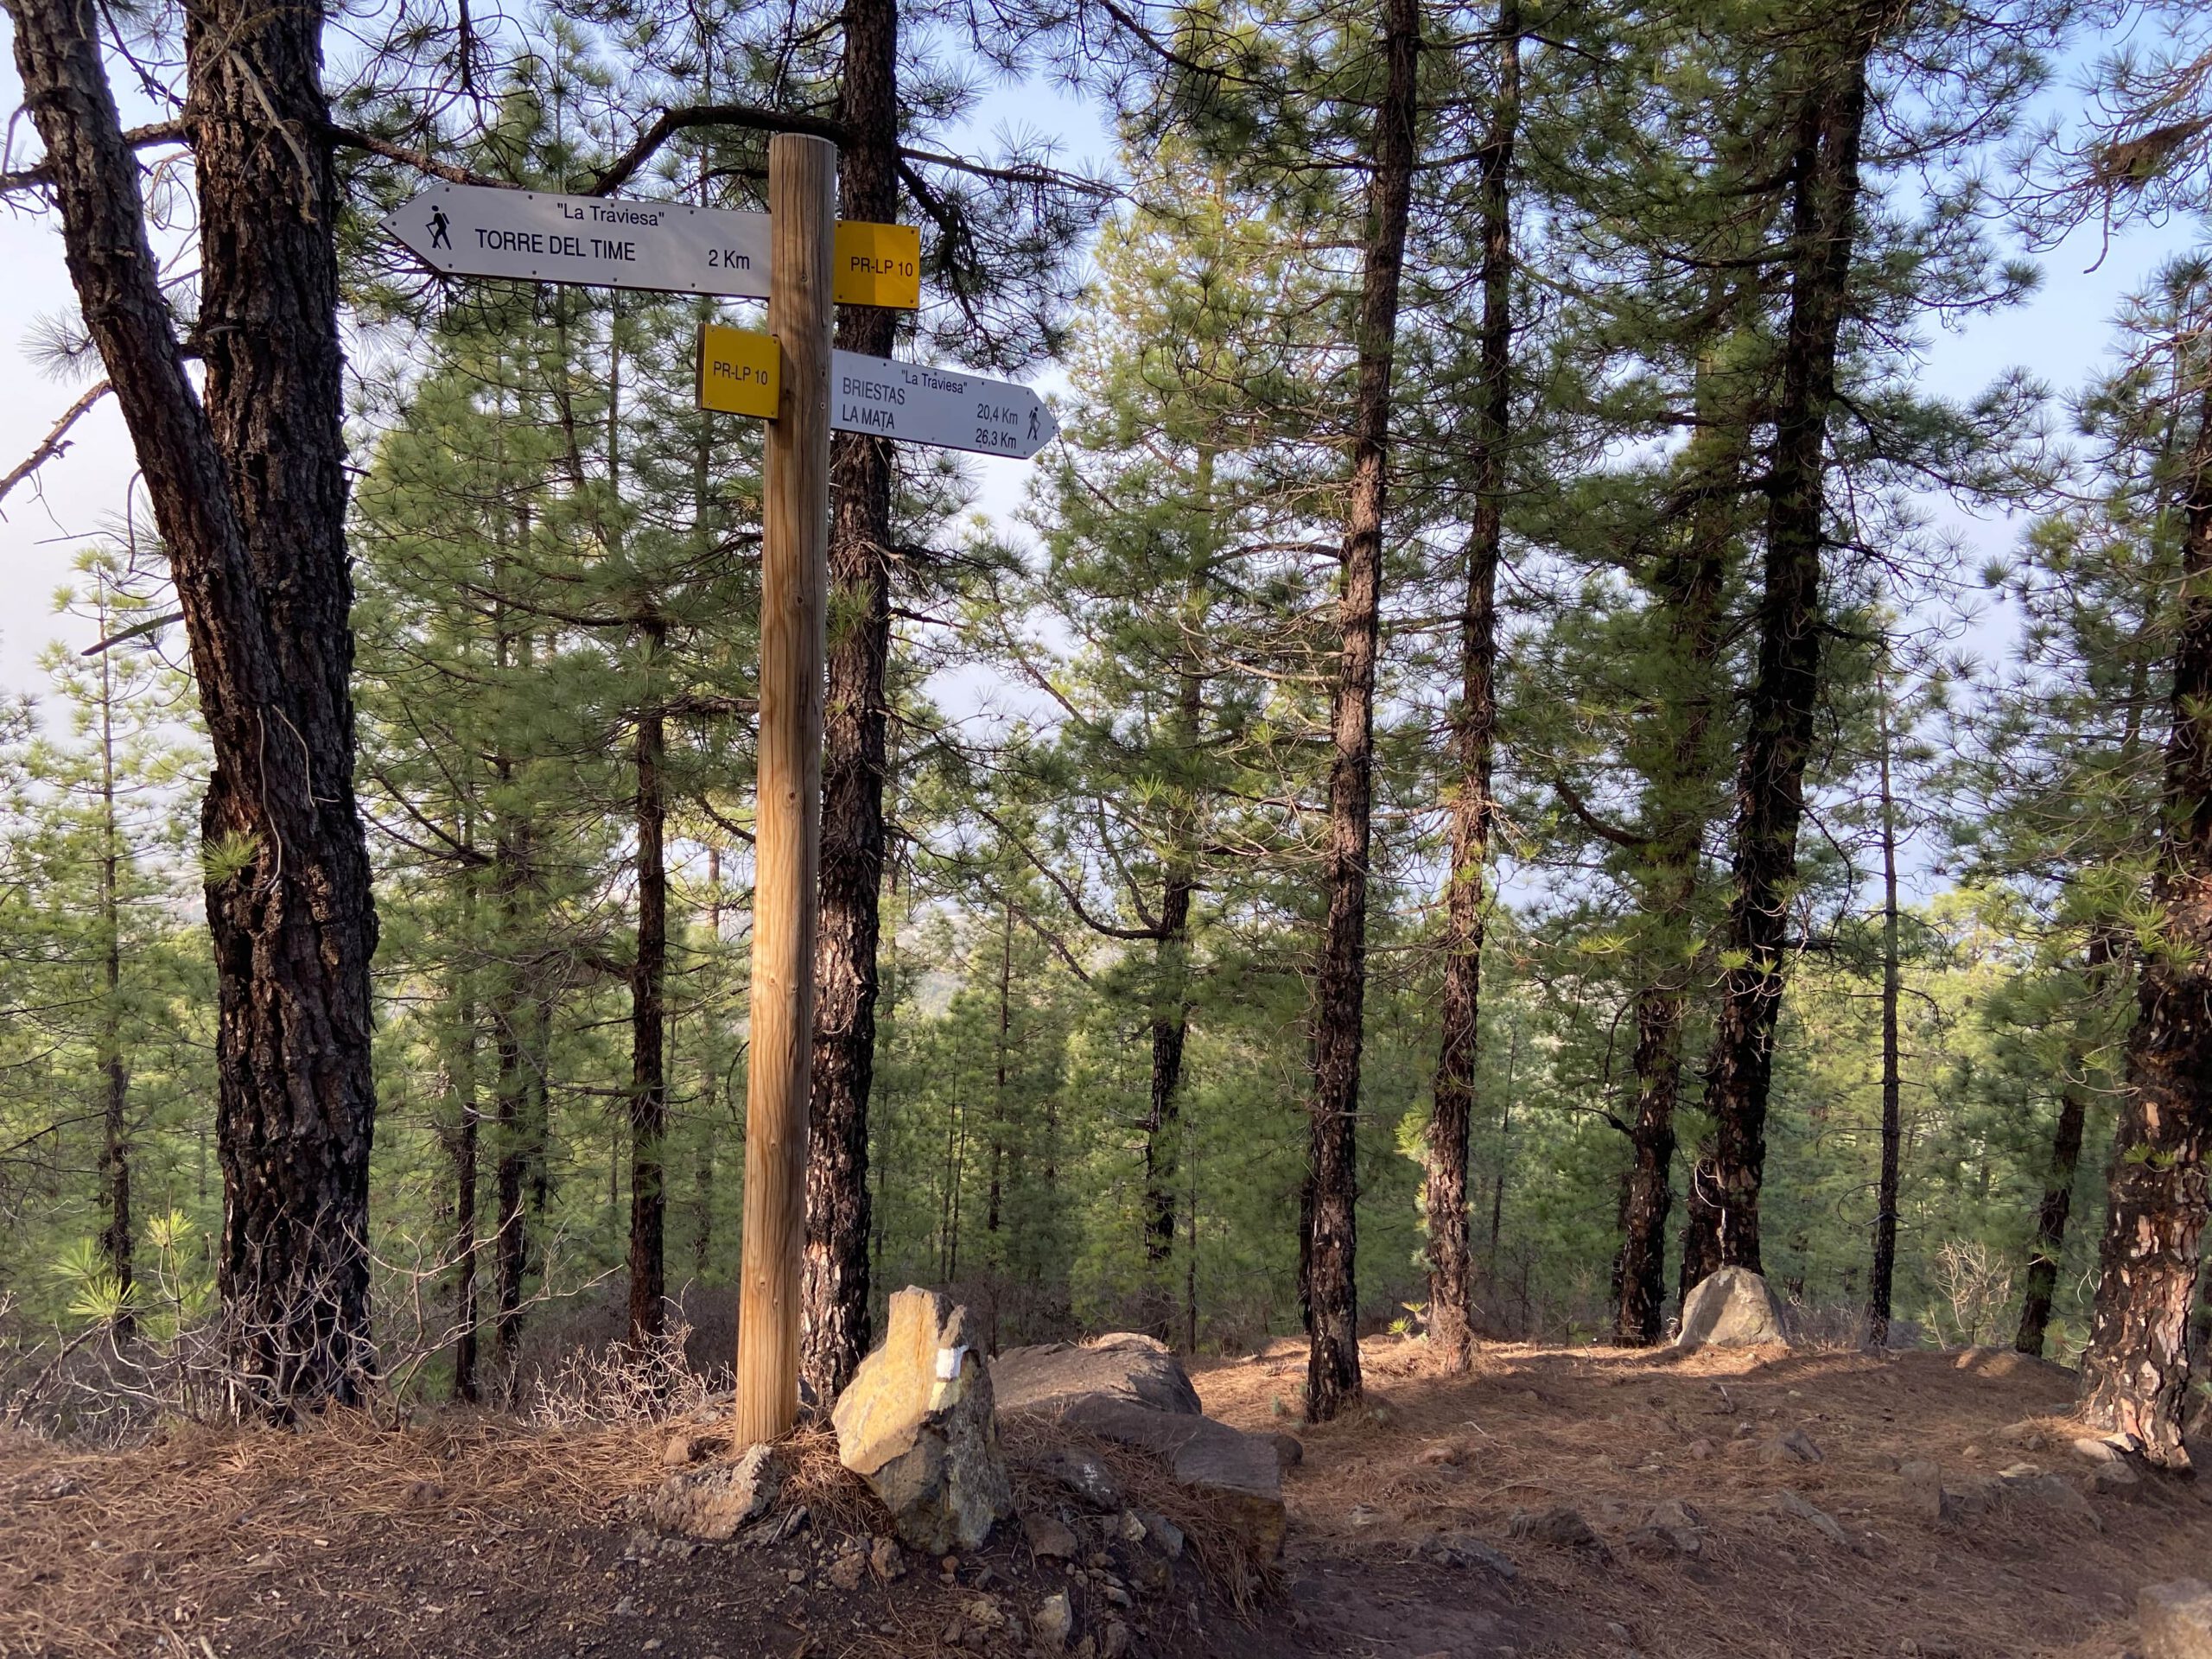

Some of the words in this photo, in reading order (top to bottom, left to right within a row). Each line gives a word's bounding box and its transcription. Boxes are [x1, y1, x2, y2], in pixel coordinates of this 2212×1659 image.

[556, 202, 584, 221] "La
[589, 206, 664, 227] Traviesa"
[475, 228, 543, 253] TORRE
[550, 235, 587, 257] DEL
[591, 239, 636, 261] TIME
[708, 249, 719, 267] 2
[724, 250, 750, 270] Km
[850, 256, 893, 275] PR-LP
[899, 262, 913, 276] 10
[713, 360, 751, 381] PR-LP
[754, 370, 768, 385] 10
[901, 370, 918, 385] "La
[921, 372, 967, 394] Traviesa"
[842, 377, 906, 405] BRIESTAS
[842, 404, 859, 423] LA
[861, 408, 895, 429] MATA
[976, 403, 999, 423] 20,4
[1001, 408, 1018, 425] Km
[976, 428, 998, 447] 26,3
[1001, 432, 1017, 449] Km
